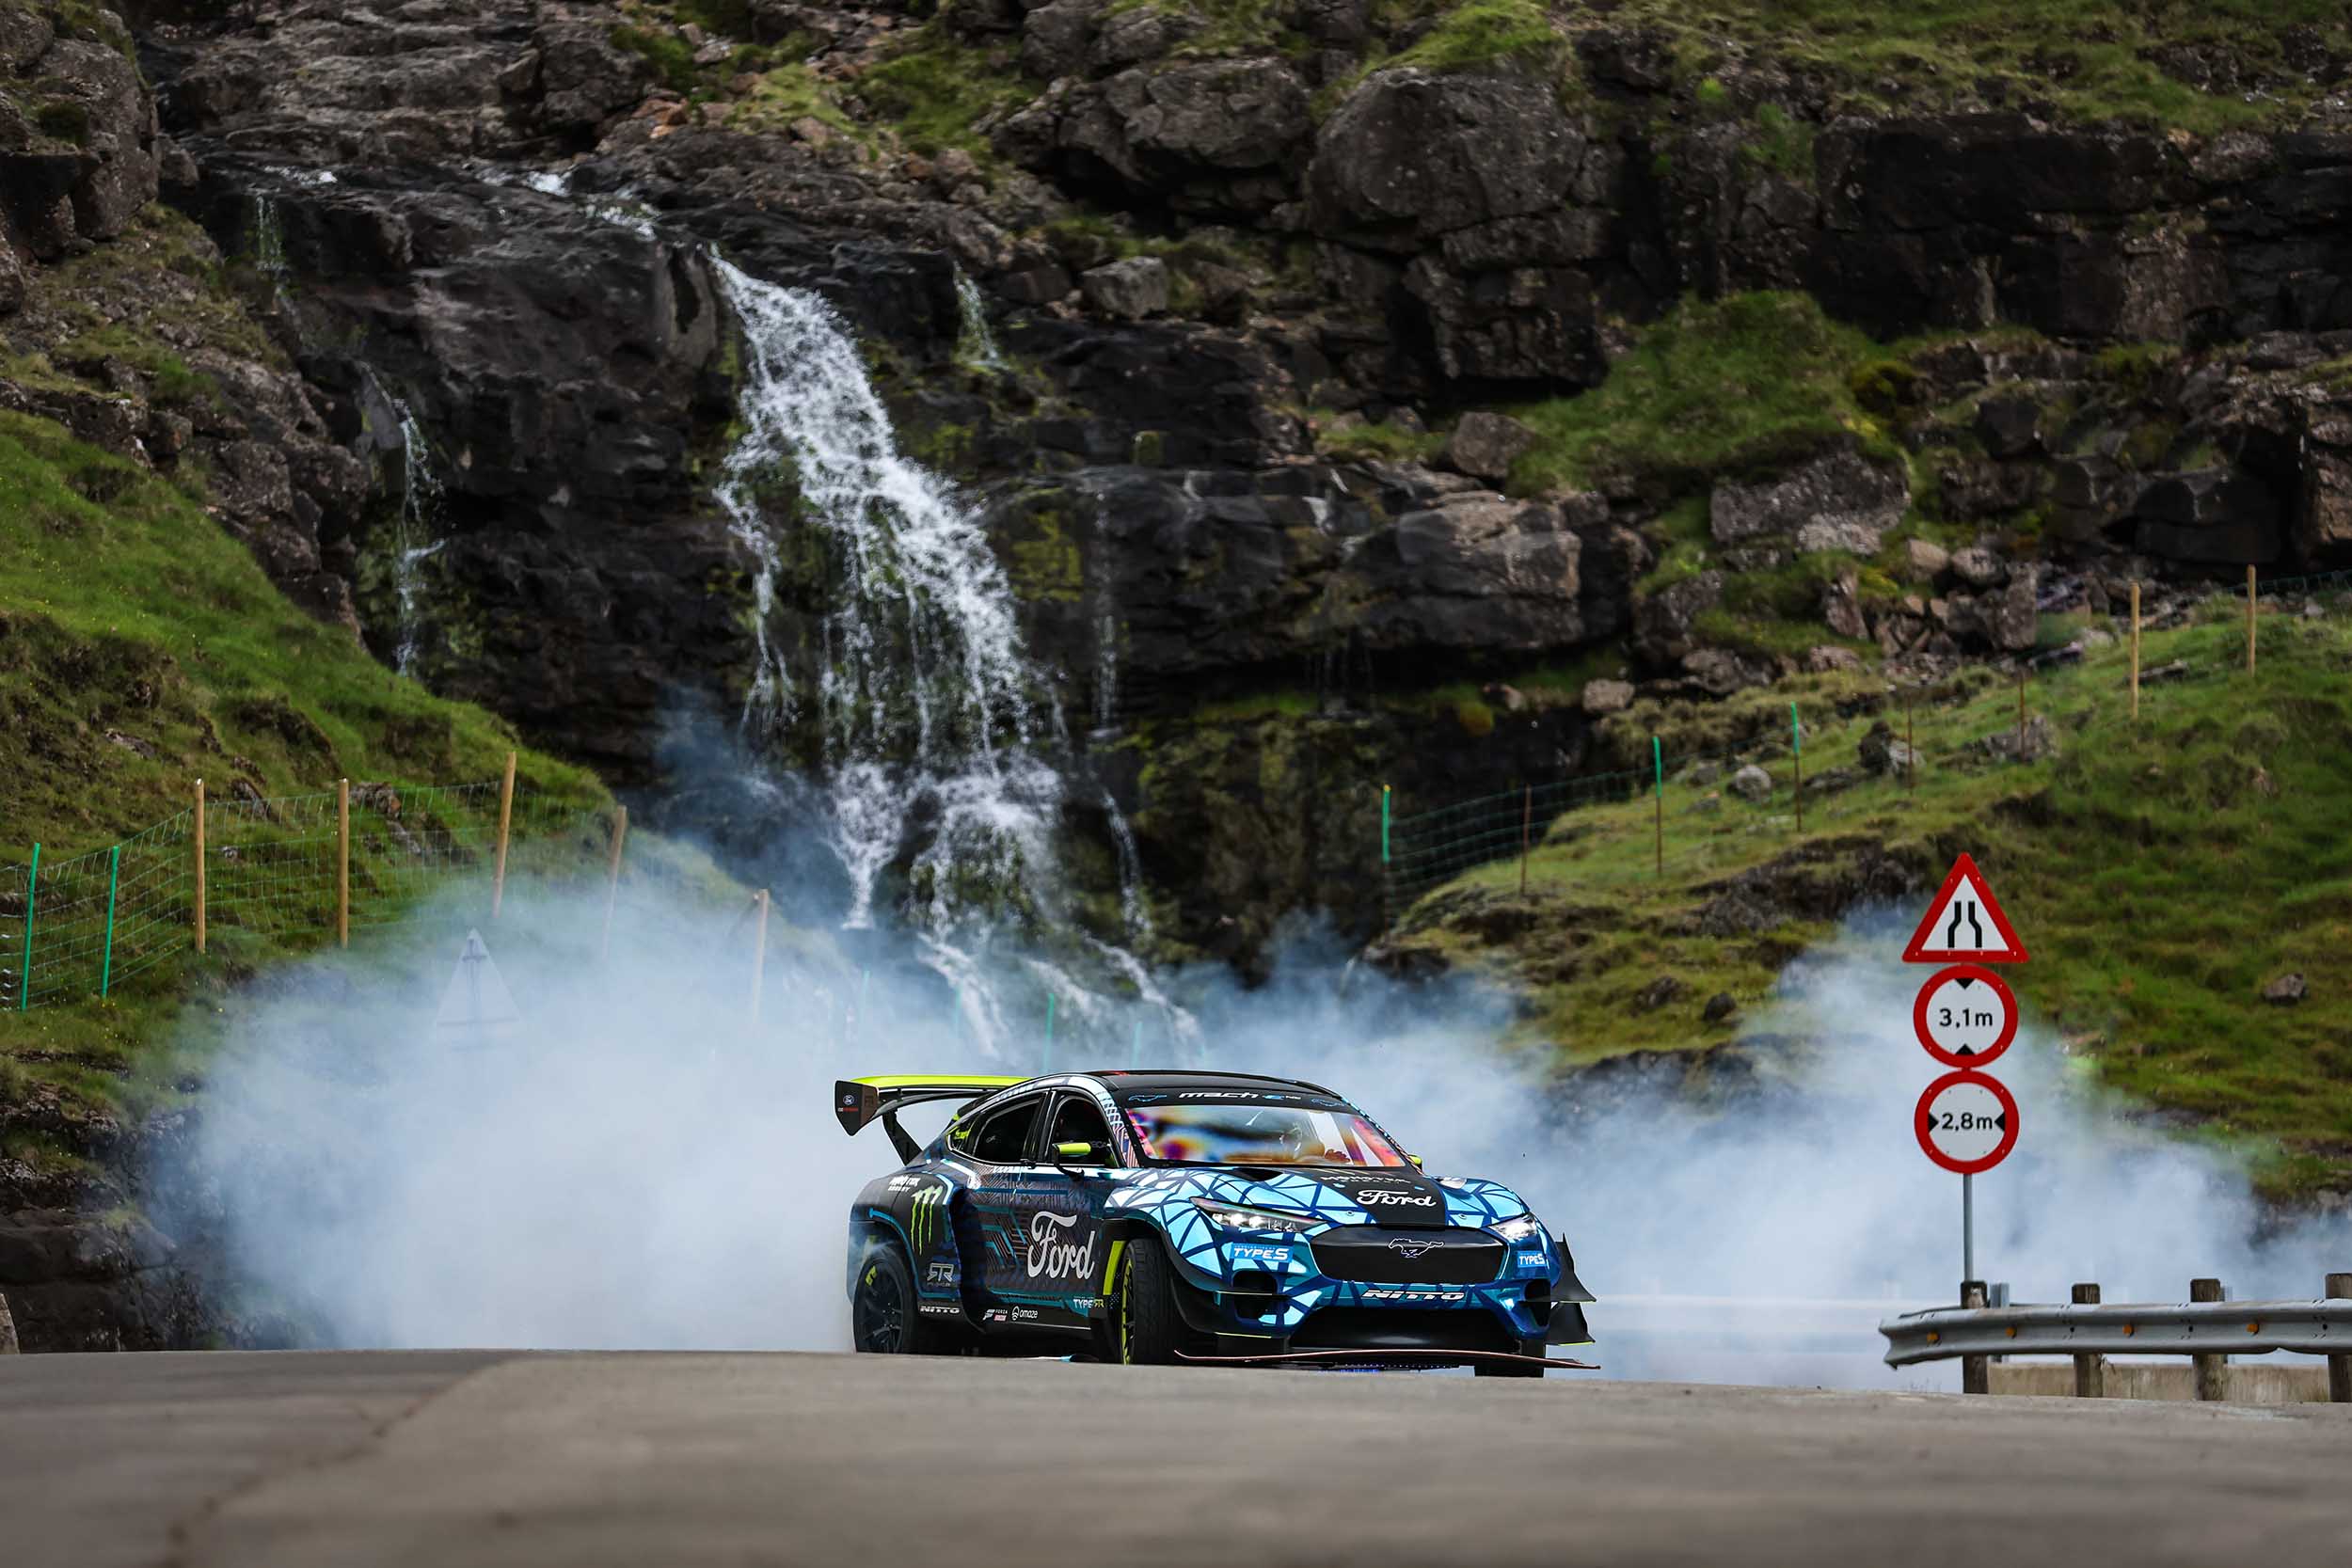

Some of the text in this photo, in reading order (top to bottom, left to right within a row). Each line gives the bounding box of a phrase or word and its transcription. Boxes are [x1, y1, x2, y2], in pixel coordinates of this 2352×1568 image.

[1939, 1008, 1994, 1029] 3,1m
[1942, 1113, 1994, 1132] 2,8m
[1357, 1189, 1437, 1207] Ford
[1027, 1211, 1095, 1280] Ford
[1361, 1290, 1466, 1301] NITTO
[920, 1306, 960, 1314] NITTO
